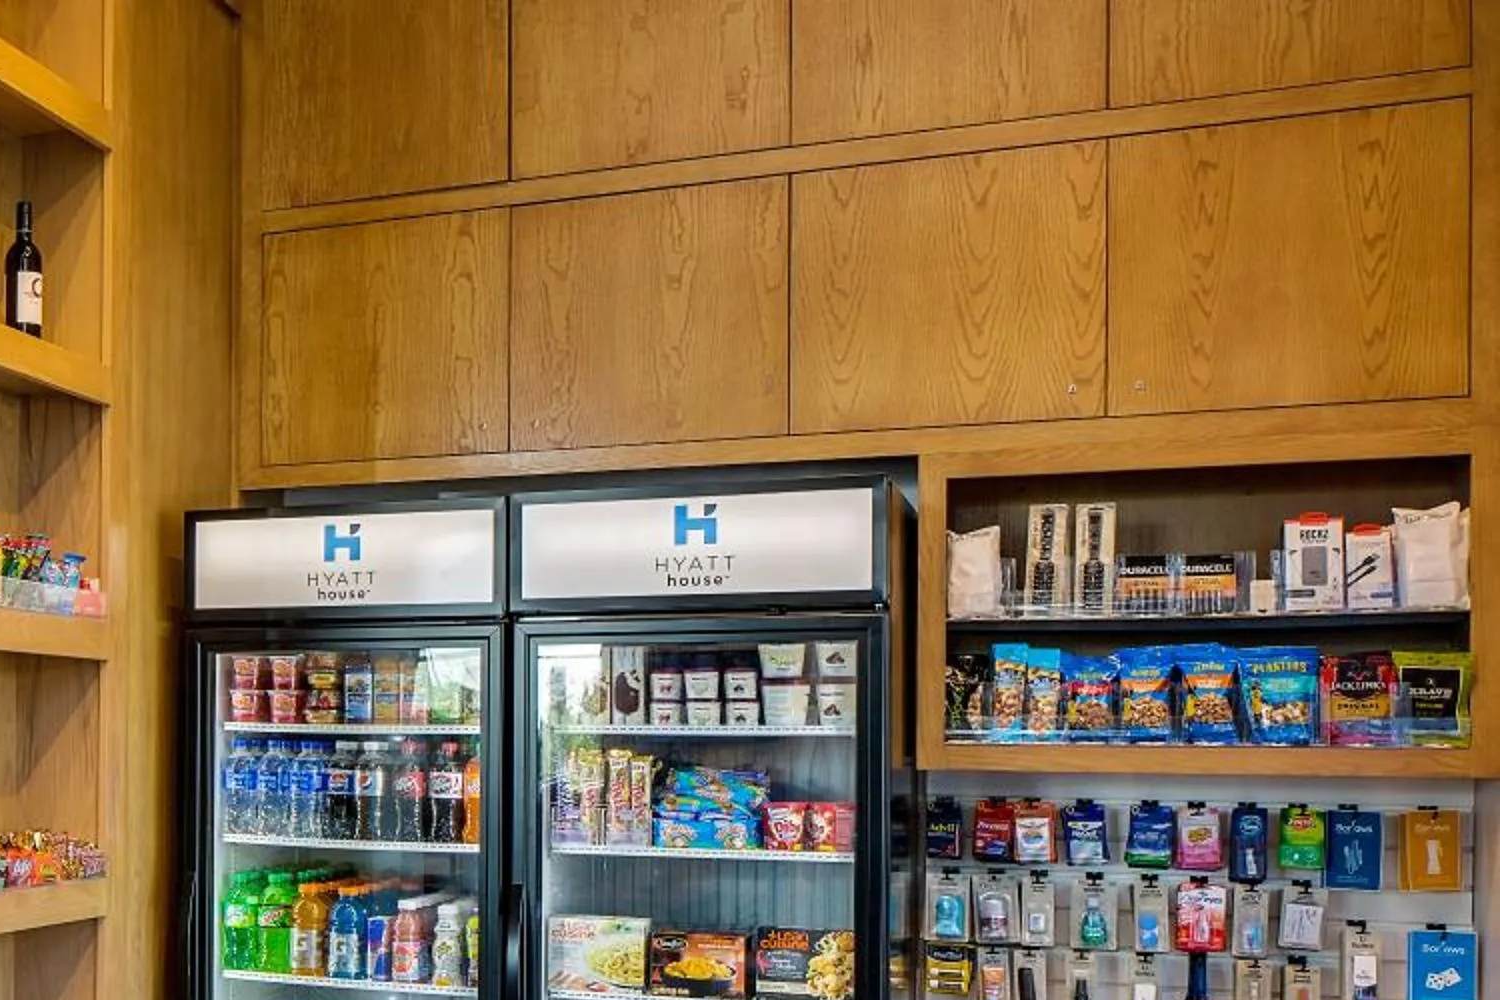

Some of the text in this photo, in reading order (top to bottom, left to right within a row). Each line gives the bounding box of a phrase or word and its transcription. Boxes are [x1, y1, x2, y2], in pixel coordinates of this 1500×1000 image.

[655, 555, 736, 573] HYATT
[307, 570, 376, 588] HYATT
[667, 574, 724, 588] house
[317, 587, 368, 601] house
